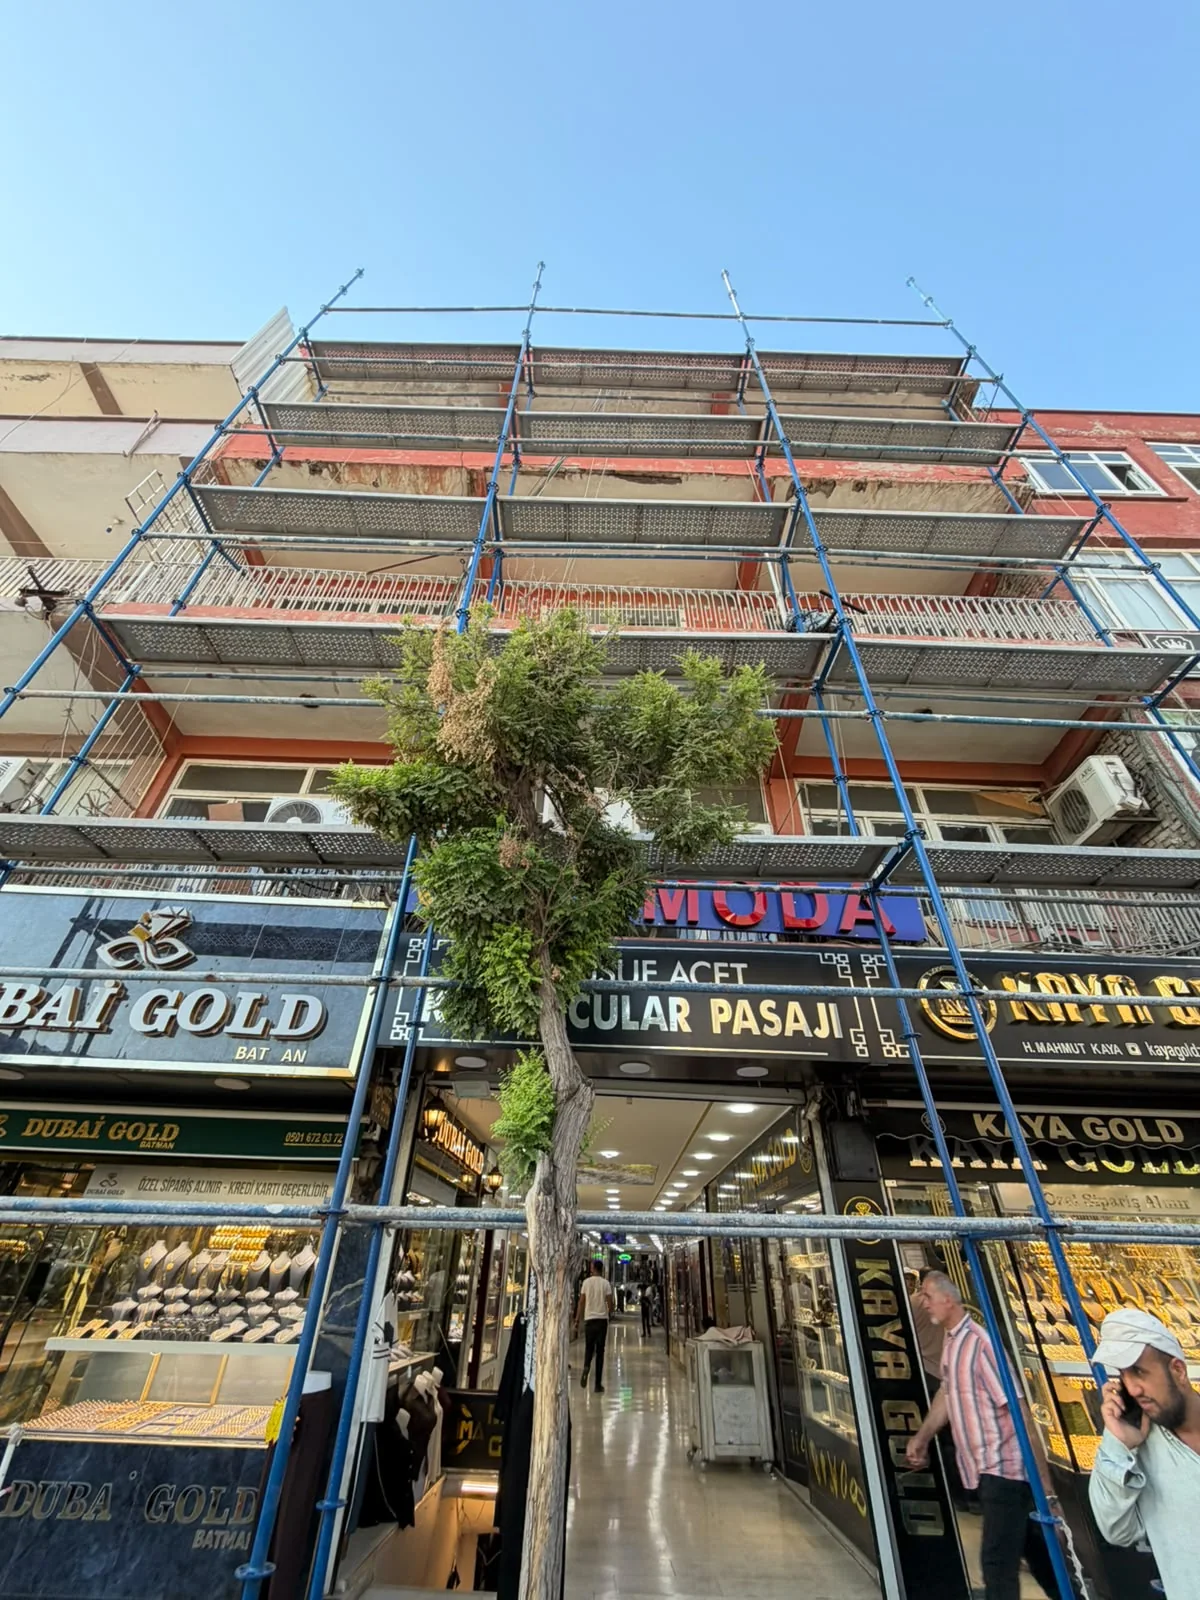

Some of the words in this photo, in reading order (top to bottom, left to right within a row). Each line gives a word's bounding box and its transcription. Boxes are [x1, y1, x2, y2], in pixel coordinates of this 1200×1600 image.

[129, 986, 328, 1041] GOLD
[710, 998, 843, 1039] PASAJI
[1090, 1042, 1123, 1056] KAYA
[21, 1115, 105, 1140] DUBAİ
[108, 1121, 180, 1142] GOLD
[1081, 1116, 1185, 1143] GOLD
[139, 1141, 175, 1150] BATMAN
[466, 1140, 485, 1175] GOLD
[192, 1179, 222, 1194] ALINIR
[228, 1180, 255, 1195] KREDİ
[253, 1182, 281, 1196] KARTI
[855, 1258, 912, 1380] KAYA
[144, 1484, 259, 1525] GOLD
